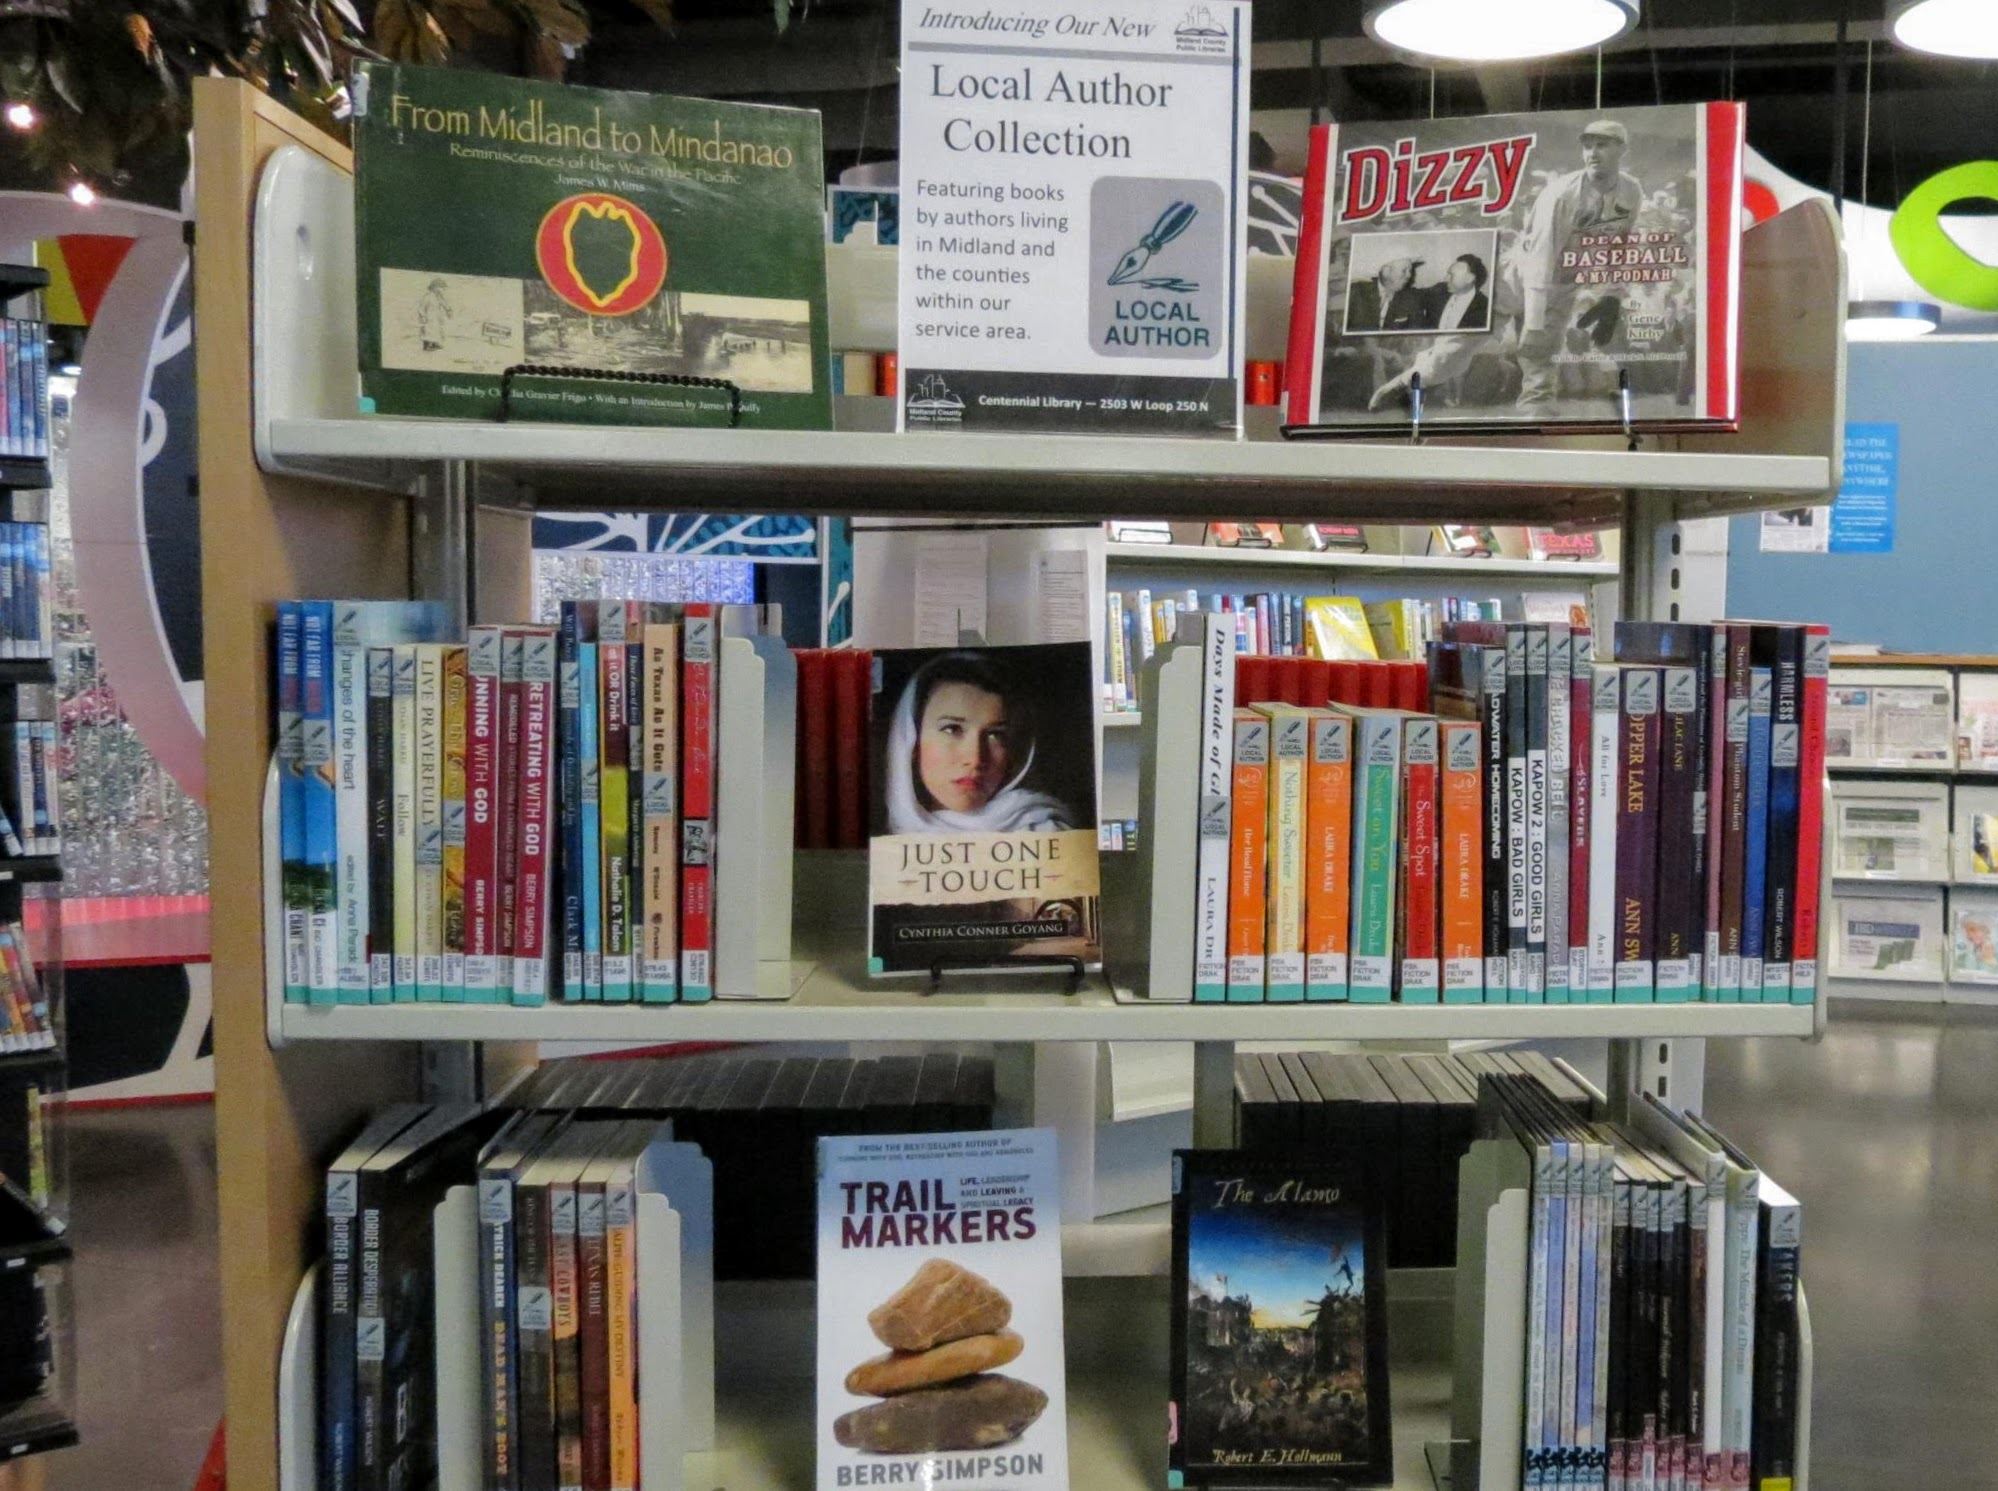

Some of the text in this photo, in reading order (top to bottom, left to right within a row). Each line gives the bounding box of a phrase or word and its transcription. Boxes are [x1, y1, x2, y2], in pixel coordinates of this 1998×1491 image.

[919, 7, 1157, 38] Introducing Our New
[931, 64, 1173, 107] Local Author
[391, 94, 793, 169] From Midland to Mindanao
[943, 118, 1133, 159] Collection
[450, 142, 564, 168] Reminiscences
[916, 179, 1066, 203] Featuring books
[1338, 133, 1536, 224] Dizzy
[916, 209, 1069, 233] by authors living
[1581, 234, 1640, 246] DEAN
[916, 238, 1056, 257] in Midland and
[1562, 247, 1688, 268] BASEBALL
[916, 265, 1031, 284] the counties
[1574, 269, 1672, 284] & MY PODNAH
[916, 293, 1012, 311] within our
[1115, 300, 1201, 322] LOCAL
[915, 321, 1032, 340] service area.
[1104, 326, 1210, 347] AUTHOR
[978, 395, 1209, 413] Centennial Library 2503 W Loop 250 N
[282, 651, 299, 675] FROM
[305, 653, 322, 678] FROM
[608, 671, 621, 721] OR Drink
[653, 647, 665, 772] As Texas As It Gets
[1209, 629, 1226, 769] Days Made of
[1779, 661, 1795, 721] HARMLESS
[343, 709, 361, 790] of the heart
[421, 660, 437, 829] LIVE PRAYERFULLY
[1730, 646, 1746, 831] Stevie-girl Phantom Student
[474, 743, 488, 781] WITH
[1599, 736, 1610, 798] All Love
[473, 787, 487, 823] GOD
[1550, 779, 1566, 821] BELL
[1628, 769, 1645, 813] LAKE
[396, 794, 410, 837] Follow
[523, 680, 544, 949] RETREATING WITH GOD BERRY SIMPSON
[1281, 771, 1299, 881] Nothing Sweeter
[1415, 800, 1431, 840] Sweet
[1490, 763, 1500, 859] HOMECOMING
[1576, 776, 1587, 848] SLAYERS
[900, 838, 1061, 871] JUST ONE
[1369, 769, 1390, 917] Sweet on You Laura
[1413, 845, 1431, 877] Spot
[1458, 832, 1470, 864] LAURA
[1510, 767, 1525, 917] KAPOW BAD GIRLS
[1529, 759, 1544, 934] KAPOW 2 GOOD GIRLS
[475, 880, 485, 914] BERRY
[609, 856, 624, 901] Nathalie
[918, 868, 1043, 893] TOUCH
[1243, 870, 1253, 897] Home
[346, 898, 358, 927] Anna
[566, 895, 581, 931] Clark
[1205, 877, 1218, 931] LAURA
[1625, 897, 1641, 934] ANN
[475, 916, 485, 955] SIMPSO
[899, 922, 1063, 939] CYNTHIA CONNER GOYANG
[1728, 926, 1738, 950] ANN
[1773, 888, 1785, 959] ROBERT WILSON
[839, 1179, 957, 1215] TRAIL
[980, 1187, 1017, 1197] LEAVING
[1003, 1197, 1034, 1207] LEGACY
[1213, 1179, 1340, 1208] The Alamo
[363, 1208, 380, 1249] BORDER
[841, 1207, 1037, 1249] MARKERS
[333, 1216, 349, 1314] BORDER ALLIANCE
[363, 1250, 380, 1317] DESPERATIO
[556, 1269, 573, 1327] COWBOYS
[1736, 1272, 1750, 1375] Miracle Dream
[494, 1262, 509, 1475] DEAREN DEAD MAN'S BOOT
[613, 1331, 626, 1377] DESTINY
[836, 1454, 1044, 1487] BERRY SIMPSON
[1212, 1449, 1255, 1463] Robert
[1260, 1450, 1276, 1462] E.
